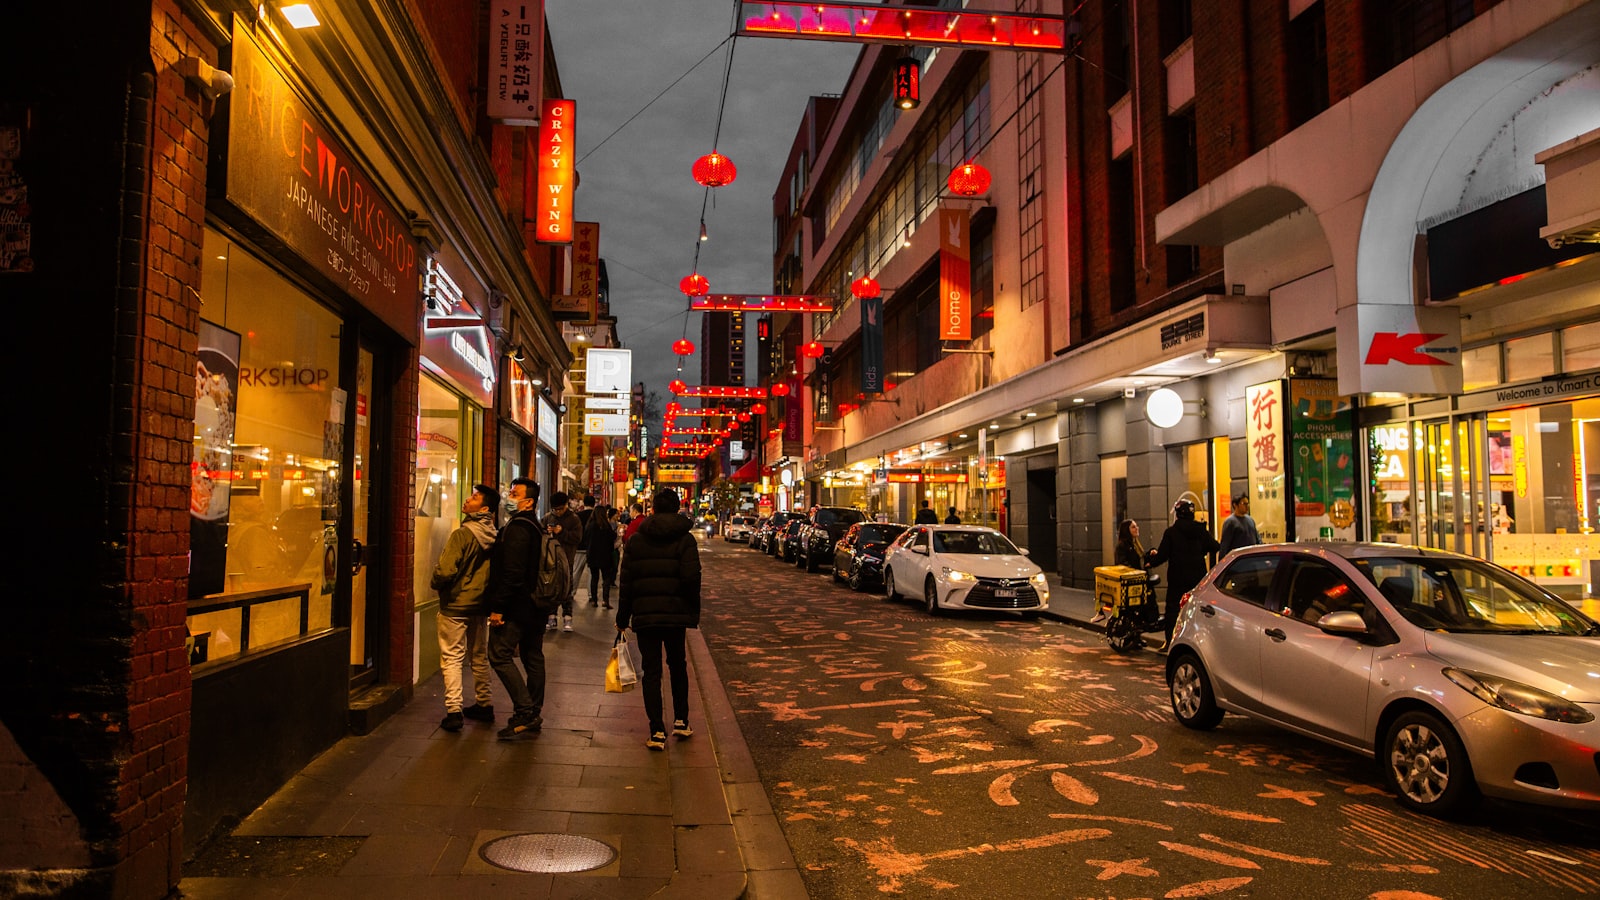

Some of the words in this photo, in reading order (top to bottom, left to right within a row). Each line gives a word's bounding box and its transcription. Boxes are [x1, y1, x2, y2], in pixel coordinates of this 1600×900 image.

[502, 8, 510, 17] A
[499, 23, 509, 69] YOGURT
[498, 74, 508, 101] COW
[551, 106, 563, 168] CRAZY
[548, 184, 563, 233] WING
[286, 176, 338, 242] JAPANESE
[340, 226, 360, 261] RICE
[362, 246, 382, 282] BOWL
[946, 291, 961, 335] home
[240, 367, 329, 386] RKSHOP
[596, 353, 622, 387] P
[866, 366, 877, 390] kids
[1496, 388, 1541, 402] Welcome
[1543, 384, 1554, 395] to
[1556, 378, 1591, 393] Kmart
[790, 408, 798, 440] clothing
[1252, 388, 1280, 473] 行運
[1307, 423, 1336, 432] PHONE
